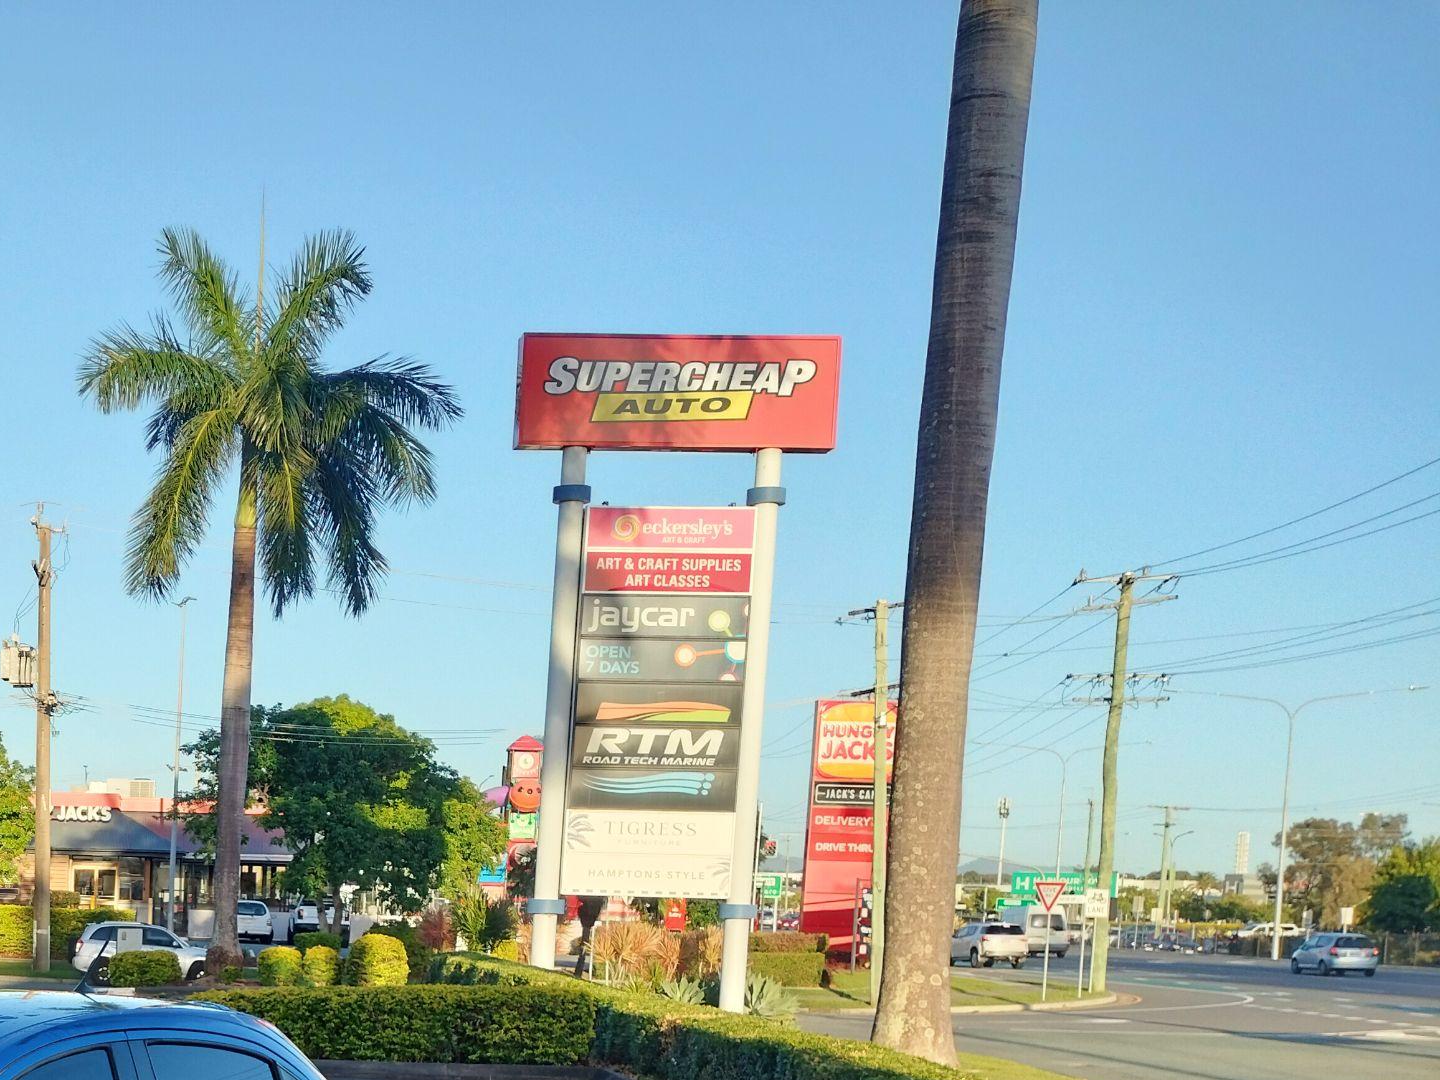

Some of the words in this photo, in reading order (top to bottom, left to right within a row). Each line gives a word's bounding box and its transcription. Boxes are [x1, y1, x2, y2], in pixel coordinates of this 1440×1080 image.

[544, 357, 817, 397] SUPERCHEAP
[612, 397, 733, 415] AUTO
[642, 517, 733, 539] eckersley's
[596, 557, 622, 570] ART
[623, 557, 635, 570] &
[637, 557, 679, 571] CRAFT
[681, 558, 742, 572] SUPPLIES
[624, 574, 651, 587] ART
[653, 574, 711, 587] CLASSES
[587, 599, 695, 633] jaycar
[585, 645, 632, 659] OPEN
[586, 661, 594, 674] 7
[599, 661, 640, 674] DAYS
[823, 724, 895, 739] HUNGY
[585, 728, 725, 756] RTM
[582, 756, 621, 765] ROAD
[624, 756, 658, 765] TECH
[660, 757, 716, 766] MARINE
[825, 788, 856, 799] JACK'S
[859, 789, 874, 799] CA
[603, 820, 697, 837] TIGRESS
[815, 842, 847, 852] DRIVE
[588, 869, 661, 879] HAMPTONS
[667, 871, 706, 880] STYLE
